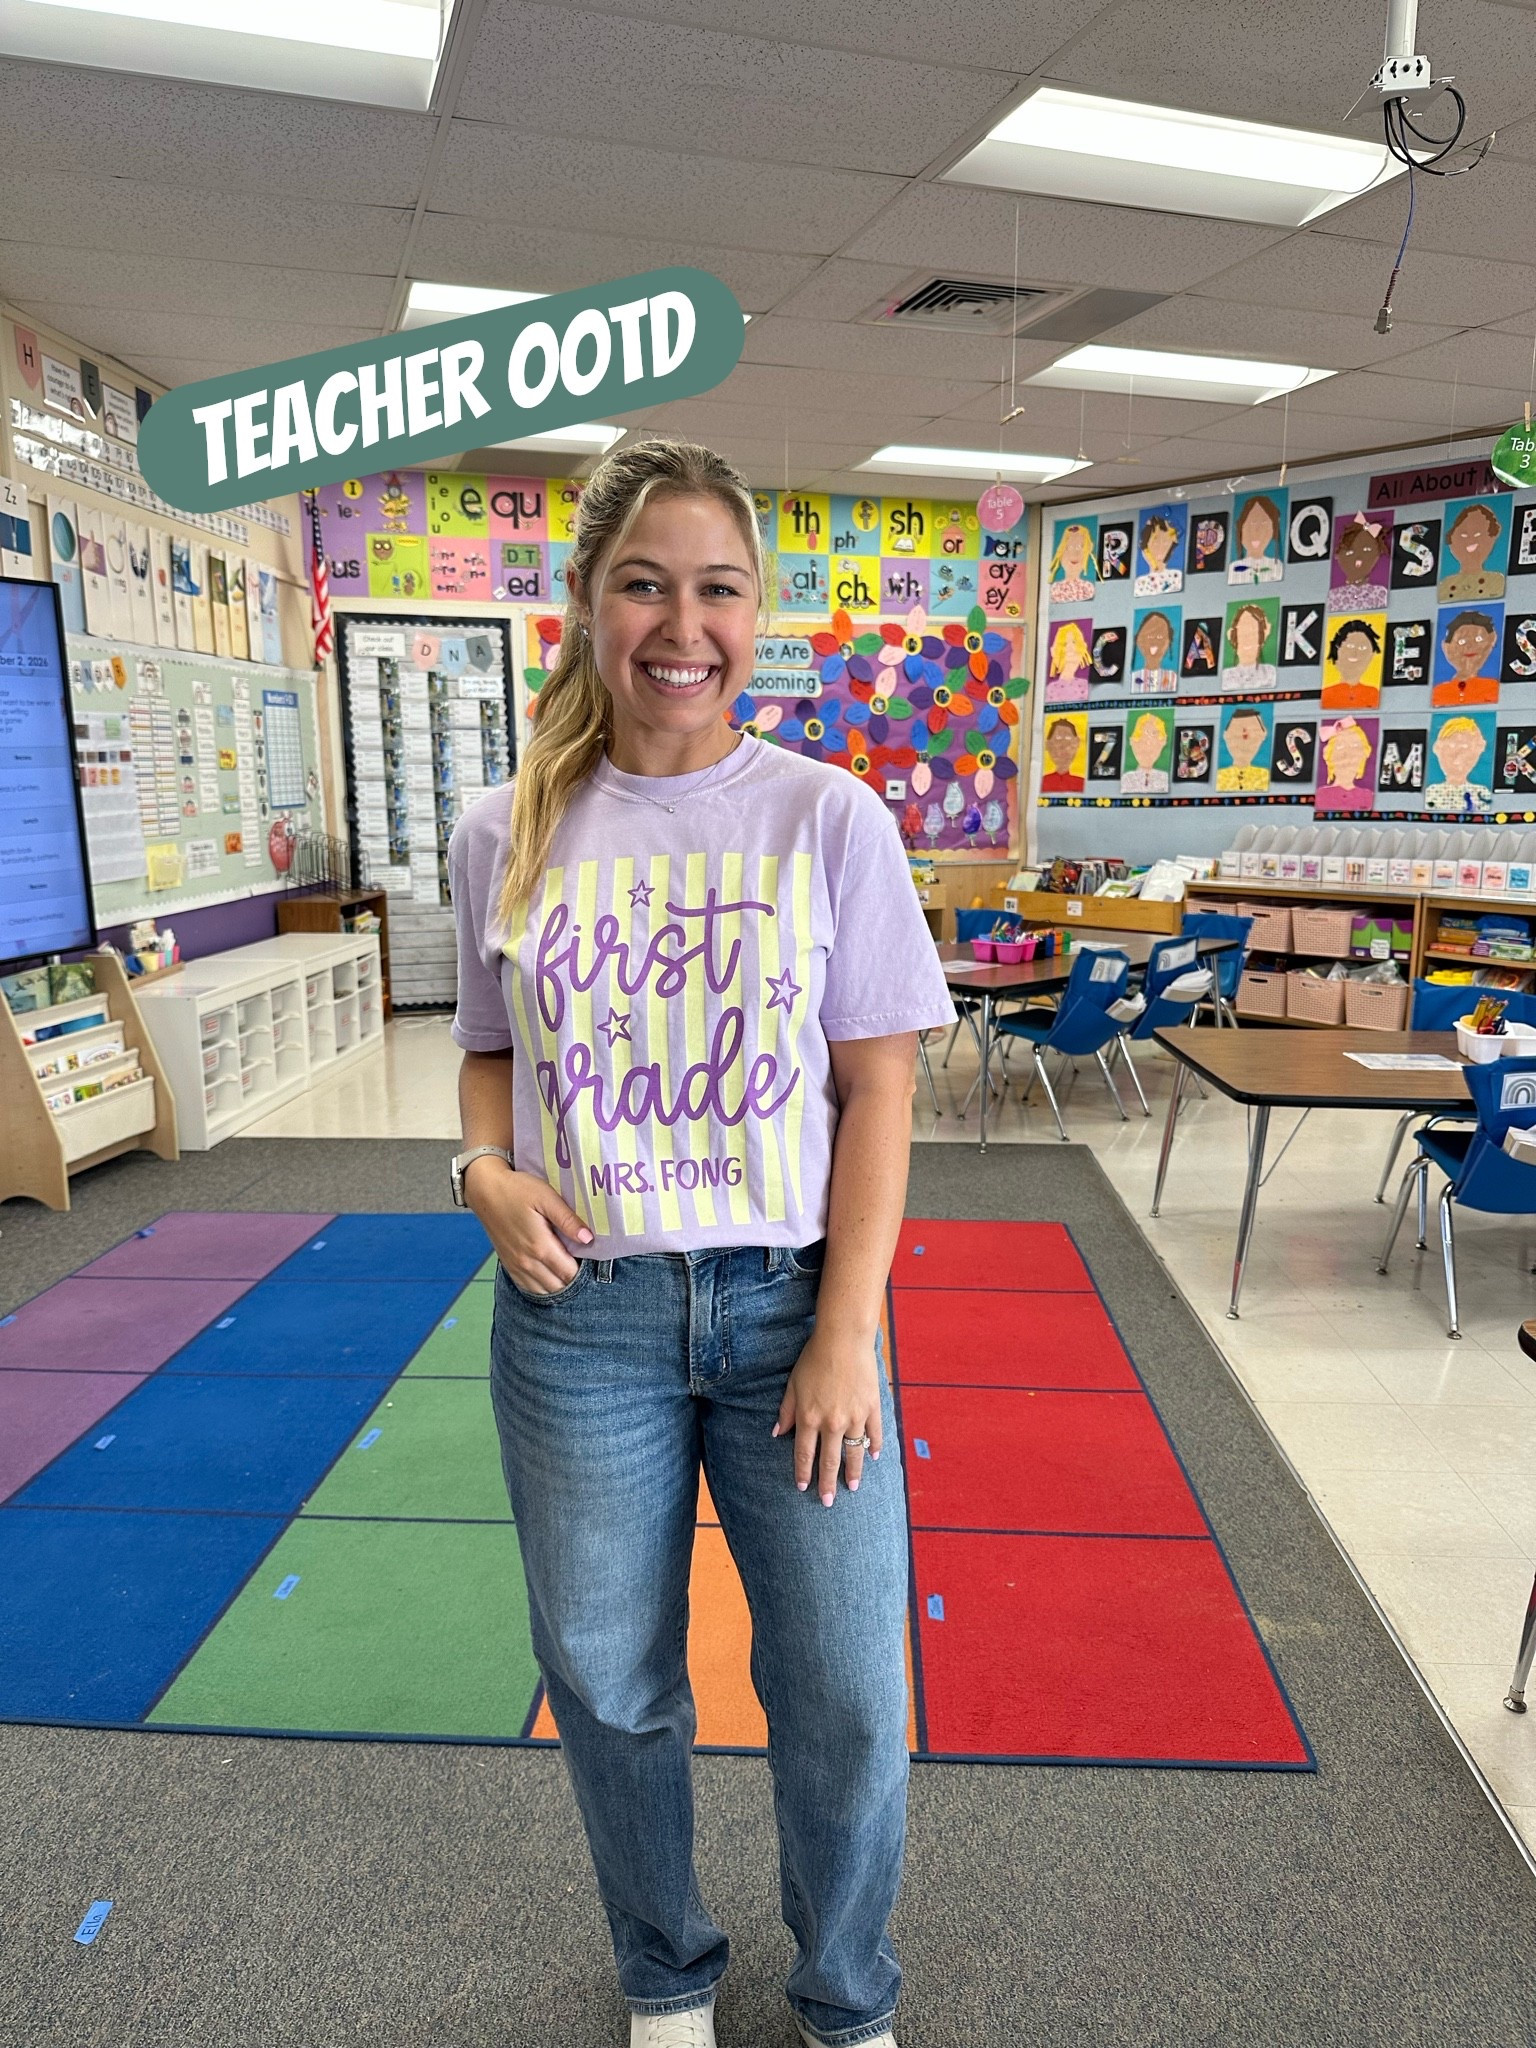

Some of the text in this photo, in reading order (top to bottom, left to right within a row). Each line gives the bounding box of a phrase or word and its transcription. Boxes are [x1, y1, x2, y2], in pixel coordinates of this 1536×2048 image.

[22, 343, 34, 368] H
[87, 375, 96, 396] E
[1510, 437, 1536, 452] Tab
[1519, 454, 1530, 469] 3
[1376, 480, 1403, 500] All
[1410, 466, 1477, 494] About
[460, 488, 483, 517] e
[490, 491, 541, 530] qu
[987, 497, 1013, 509] Table
[792, 499, 820, 534] th
[890, 502, 924, 536] sh
[834, 531, 856, 553] ph
[943, 536, 963, 554] or
[994, 539, 1022, 558] ar
[1102, 504, 1435, 578] R P Q S
[508, 573, 539, 597] ed
[793, 560, 817, 590] ai
[888, 571, 919, 597] wh
[989, 563, 1017, 585] ay
[836, 574, 868, 602] ch
[985, 588, 1009, 610] ey
[780, 644, 809, 660] Are
[1093, 630, 1120, 677] C
[1184, 621, 1217, 670] A
[1284, 610, 1318, 660] K
[1392, 624, 1426, 681] E
[745, 673, 816, 694] looming
[1093, 731, 1117, 777] Z
[1176, 729, 1209, 778] B
[1276, 727, 1312, 777] S
[1380, 743, 1424, 787] M
[536, 888, 775, 1032] first
[536, 1006, 800, 1169] grade
[590, 1157, 743, 1197] MRS. FONG
